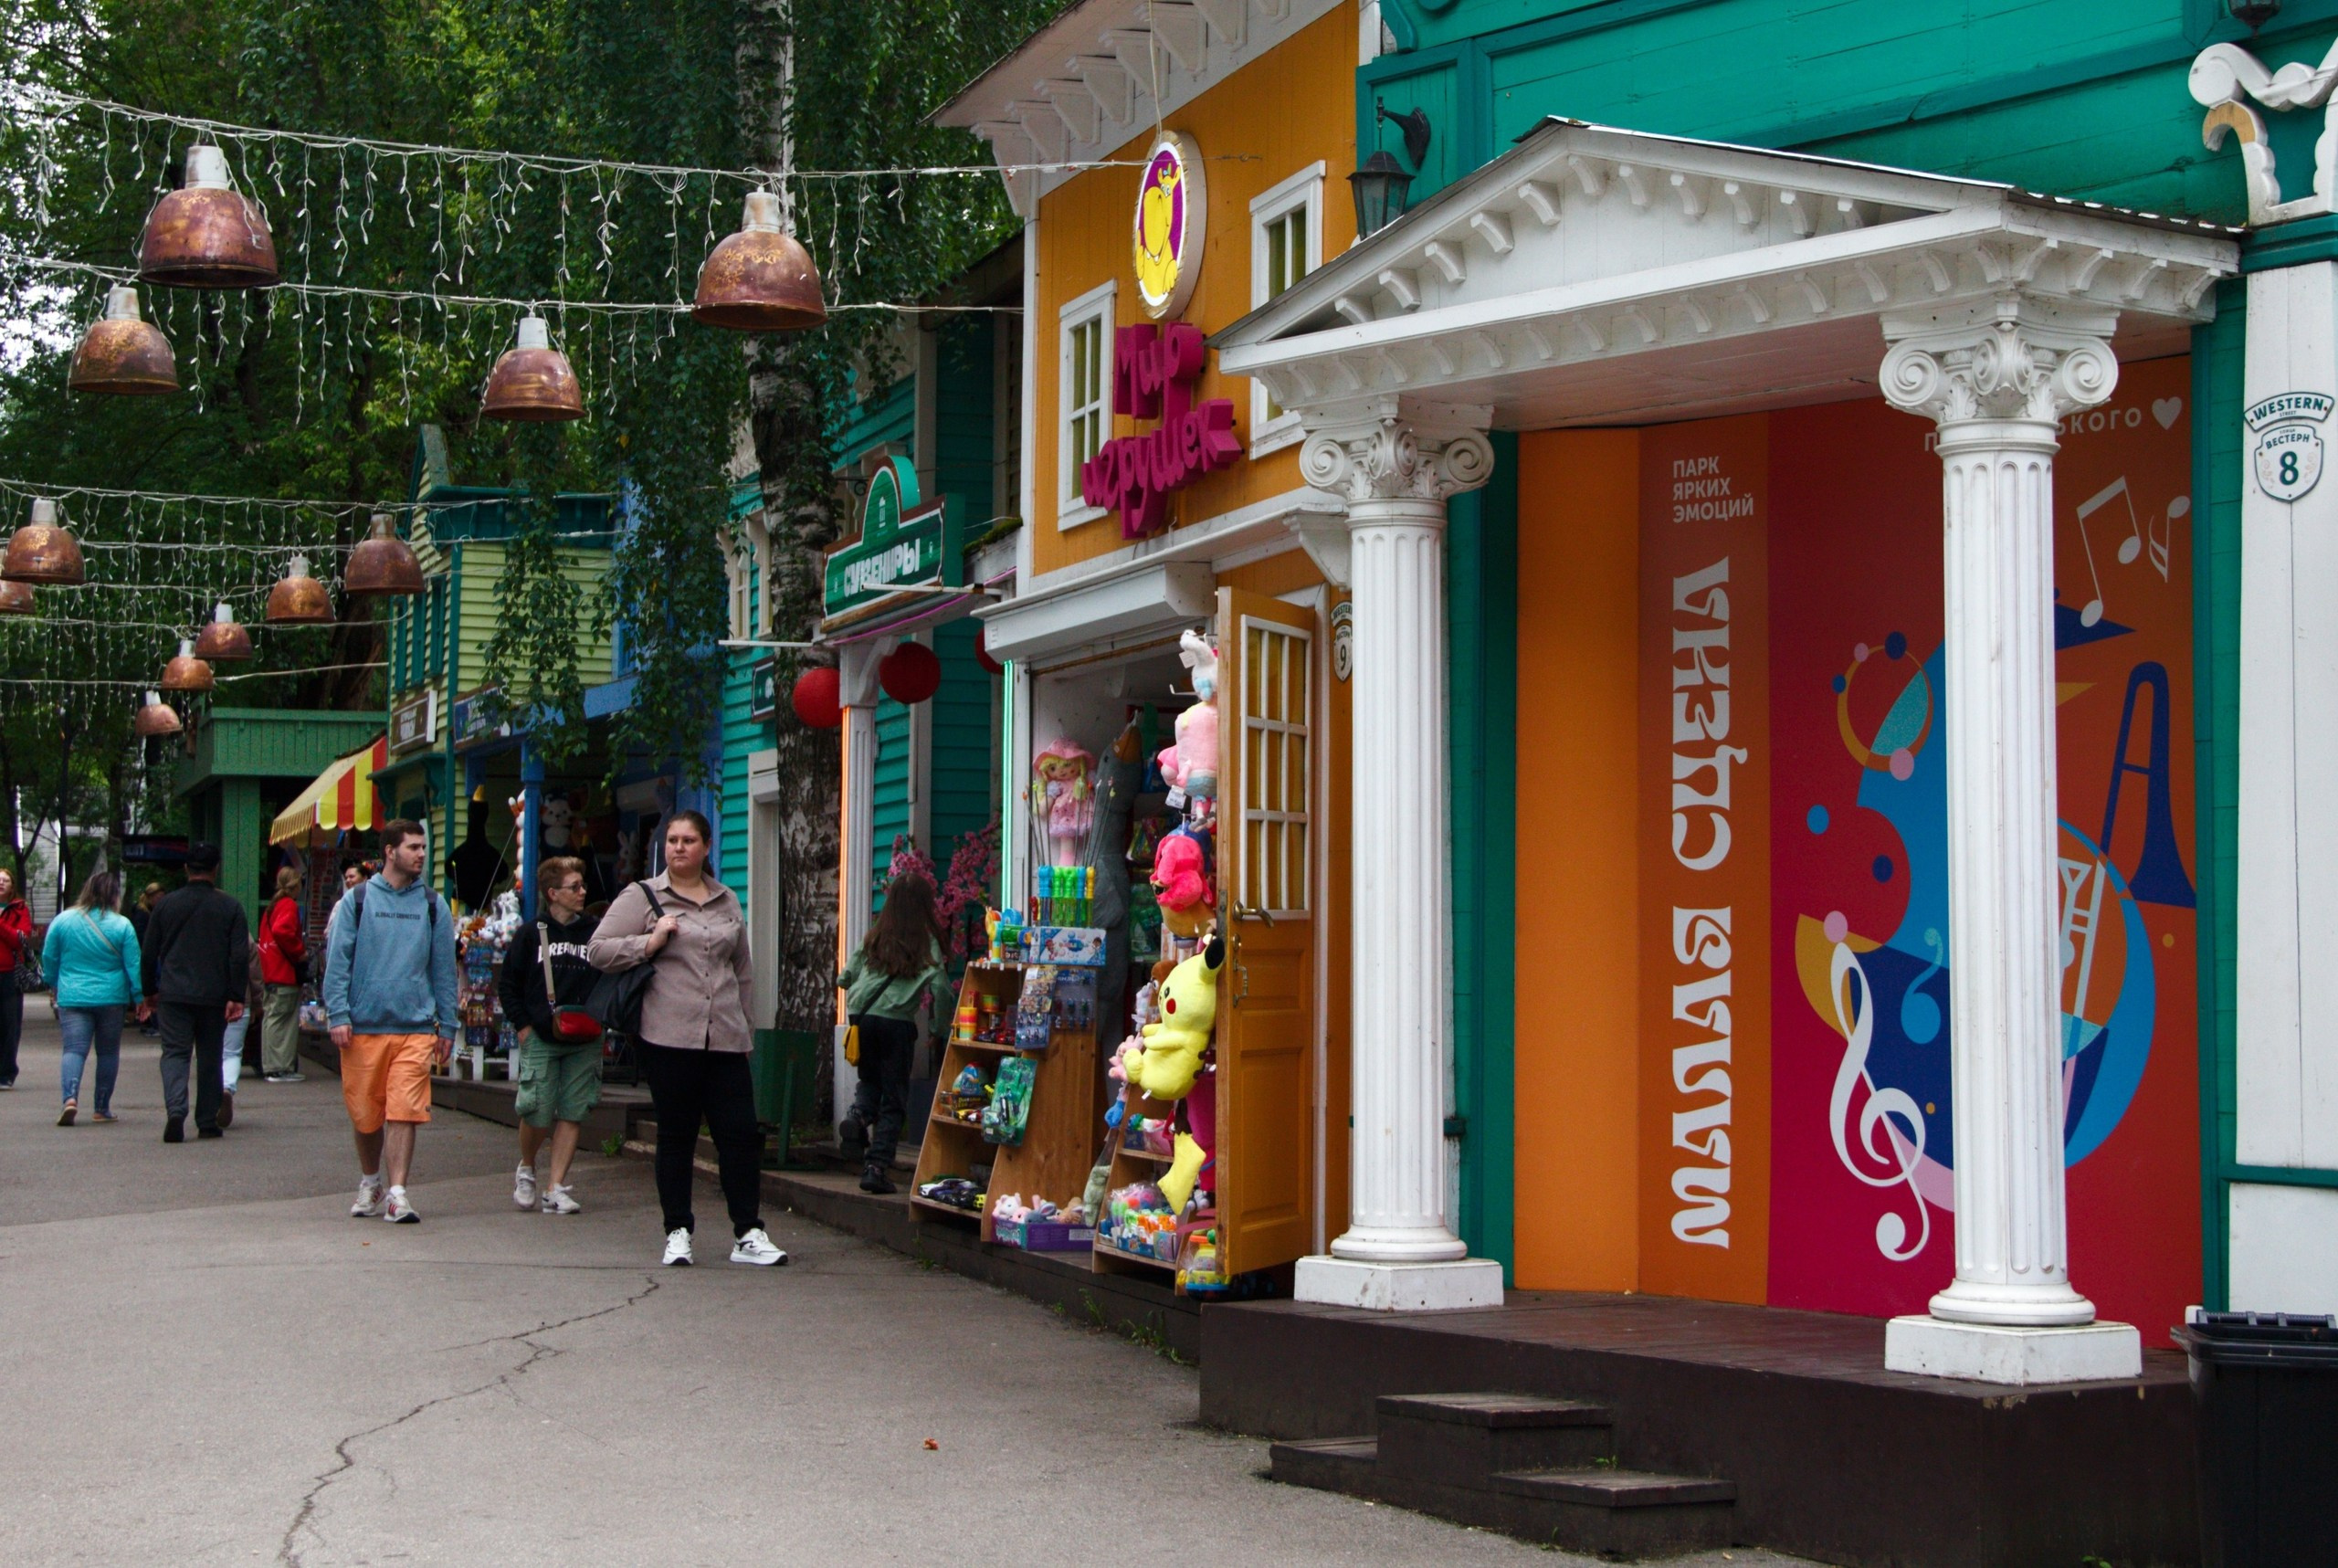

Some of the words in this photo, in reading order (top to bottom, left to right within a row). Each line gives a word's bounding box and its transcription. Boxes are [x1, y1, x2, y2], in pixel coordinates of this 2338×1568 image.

[2253, 397, 2324, 421] WESTERN
[2265, 434, 2311, 450] ВЕСТЕРН
[1673, 456, 1720, 479] ПАРК
[2279, 450, 2300, 486] 8
[1673, 477, 1731, 500] ЯРКИХ
[1672, 493, 1754, 523] ЭМОЦИЙ
[844, 538, 921, 597] СУВЕНИРЫ
[1340, 644, 1347, 671] 9
[1671, 555, 1748, 871] СЦЕНА
[1671, 906, 1732, 1249] МАЛАЯ
